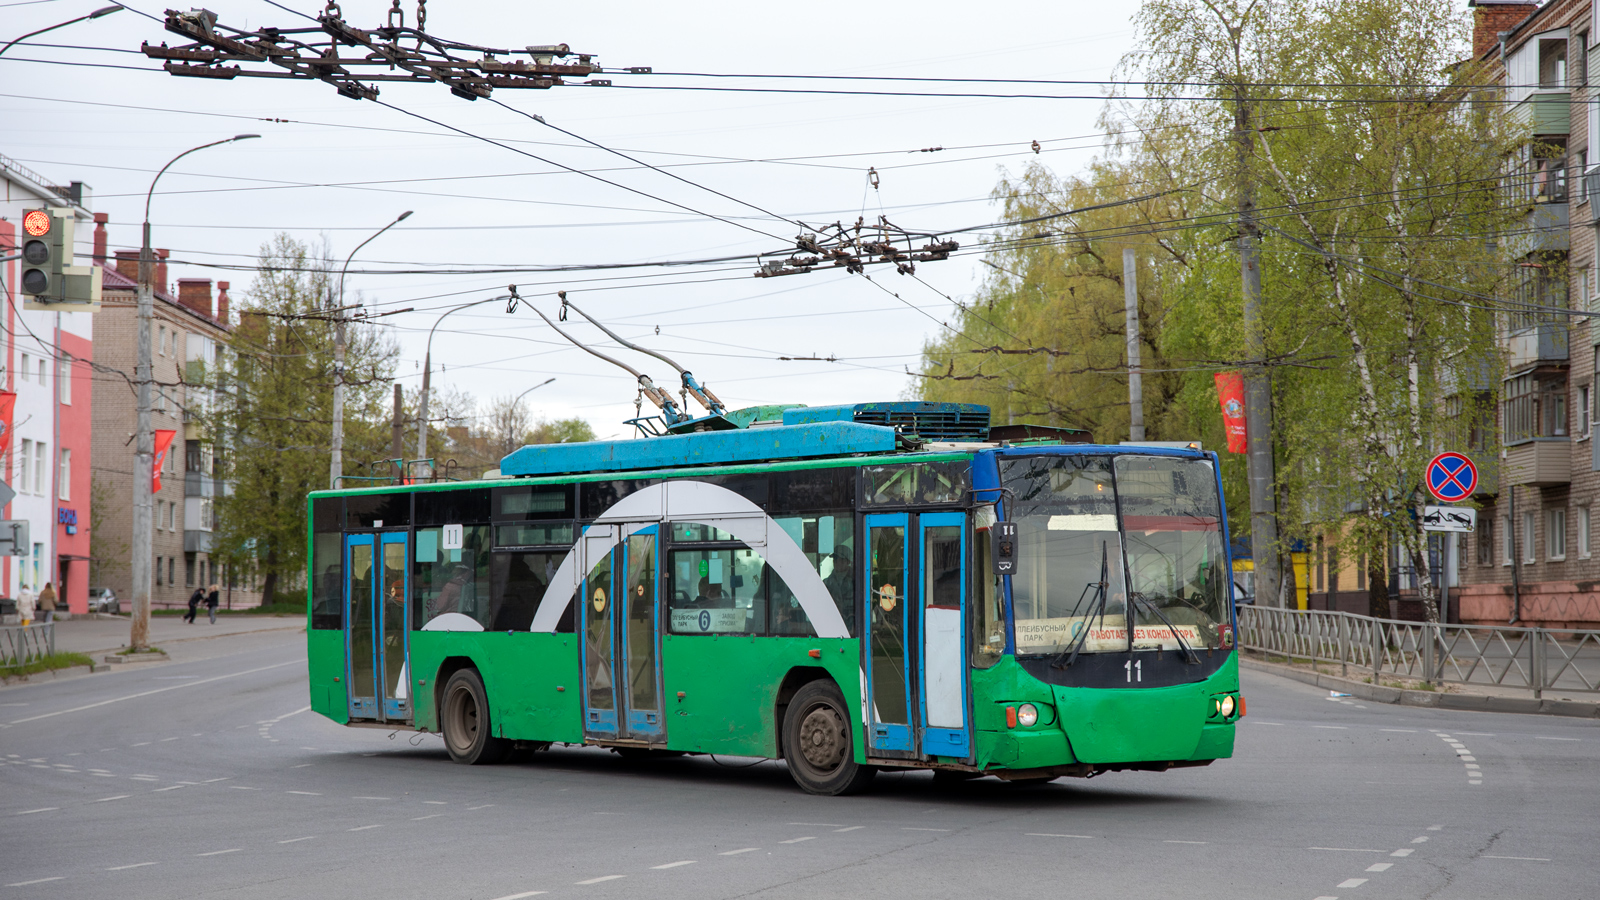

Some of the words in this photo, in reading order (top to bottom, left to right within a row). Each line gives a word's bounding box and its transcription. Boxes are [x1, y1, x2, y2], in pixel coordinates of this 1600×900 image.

[447, 529, 458, 545] 11
[1024, 634, 1043, 642] ПАРК
[1124, 659, 1142, 683] 11
